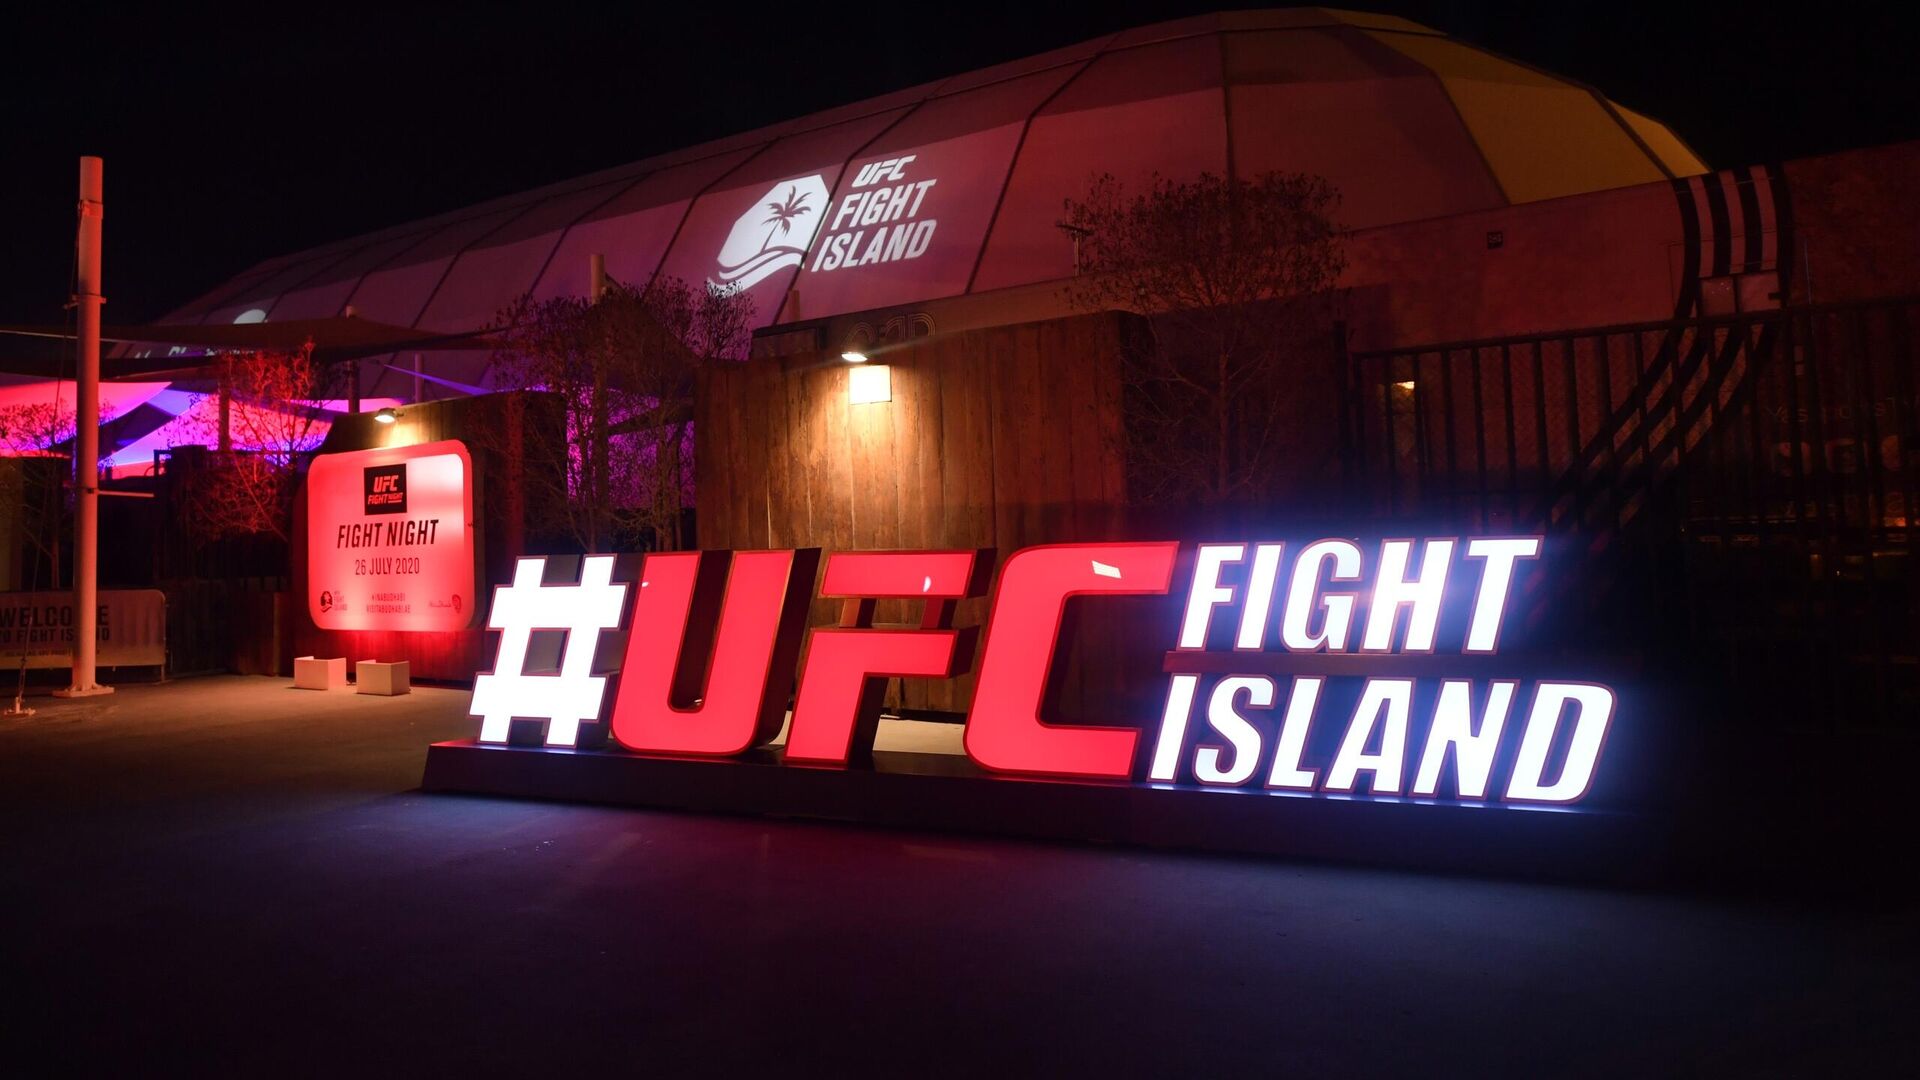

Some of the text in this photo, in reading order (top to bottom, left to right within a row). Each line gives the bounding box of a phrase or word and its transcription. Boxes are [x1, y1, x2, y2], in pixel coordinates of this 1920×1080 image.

[851, 155, 917, 188] UFC
[831, 179, 937, 231] FIGHT
[811, 219, 937, 273] ISLAND
[368, 493, 388, 505] FIGHT
[373, 475, 399, 493] UFC
[337, 519, 439, 549] FIGHT NIGHT
[355, 557, 420, 575] 26 JULY 2020
[1176, 535, 1544, 655] FIGHT
[0, 605, 109, 627] WELCOE
[1146, 672, 1617, 804] ISLAND
